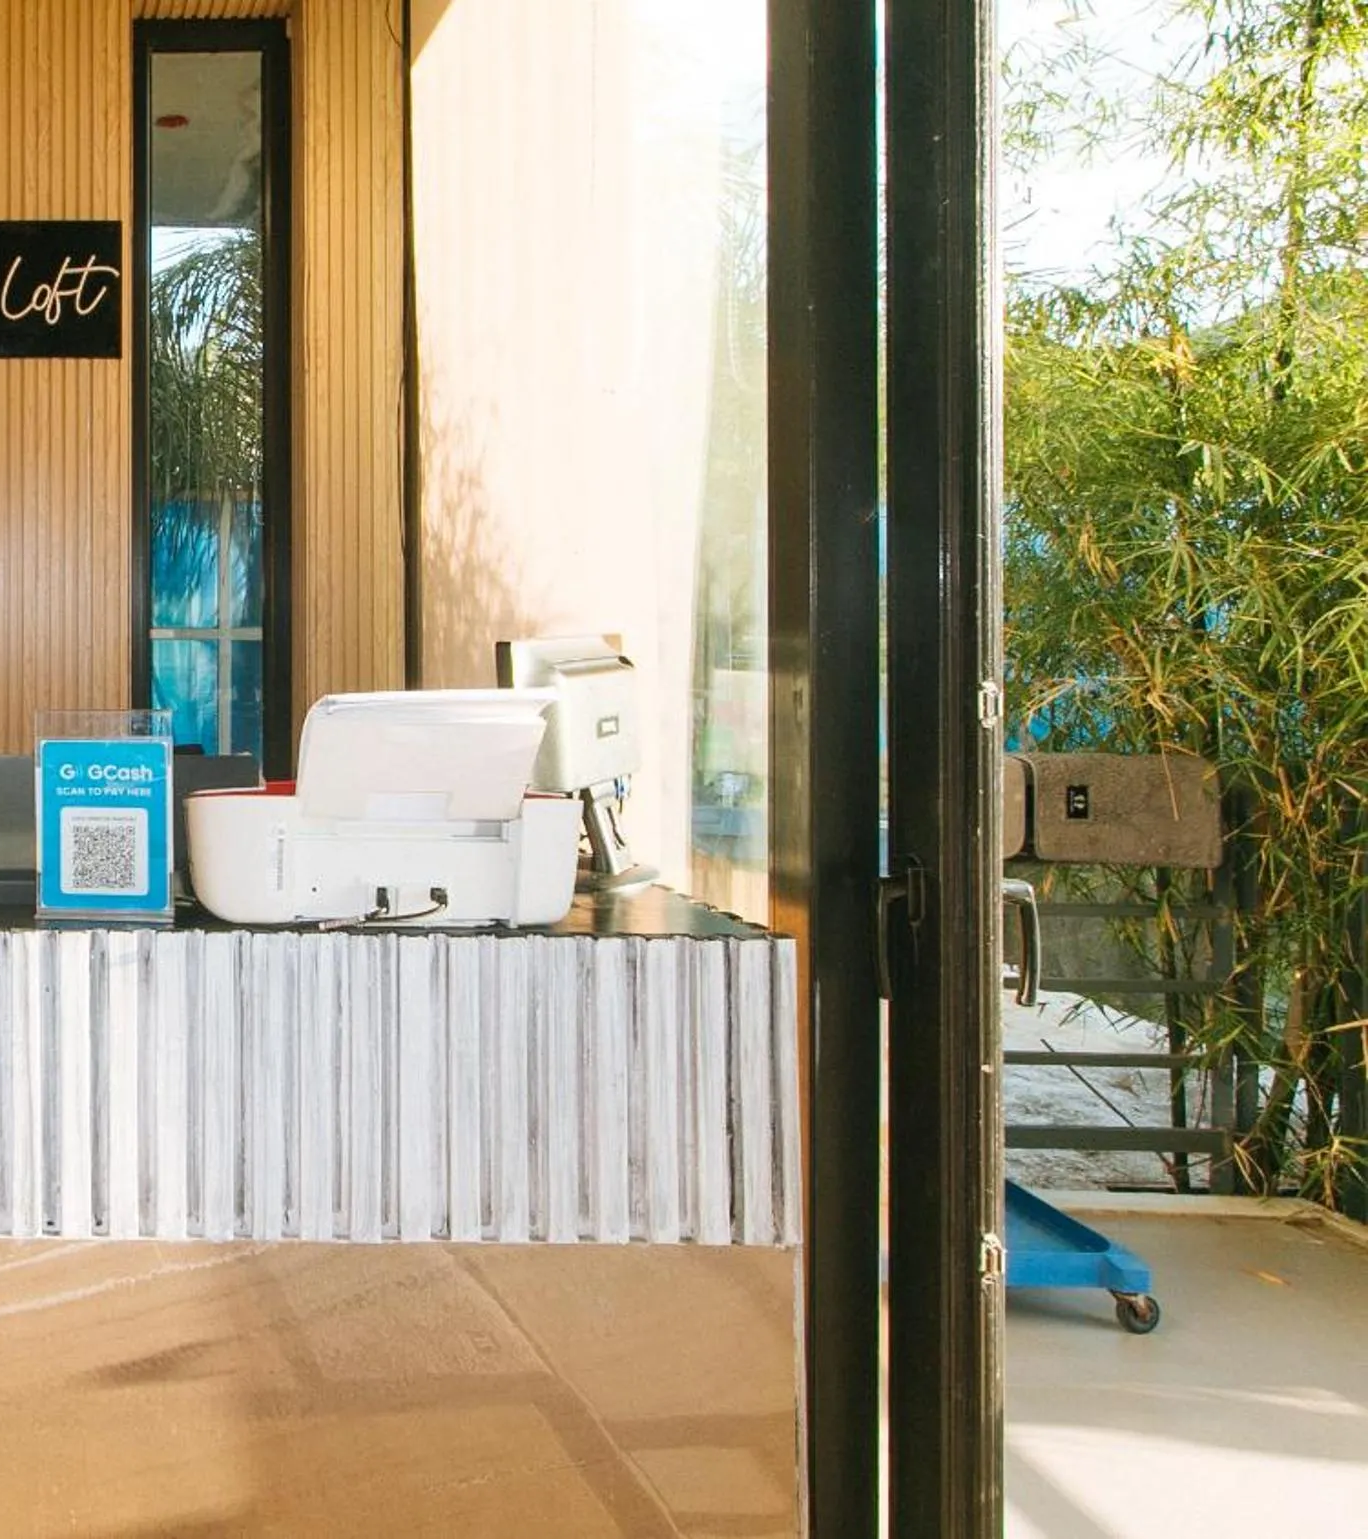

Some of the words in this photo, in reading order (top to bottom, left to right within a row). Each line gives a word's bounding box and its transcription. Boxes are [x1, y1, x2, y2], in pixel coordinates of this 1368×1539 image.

[0, 254, 121, 325] Loft
[87, 763, 153, 782] GCash
[55, 786, 86, 796] SCAN
[88, 786, 103, 796] TO
[104, 786, 125, 797] PAY
